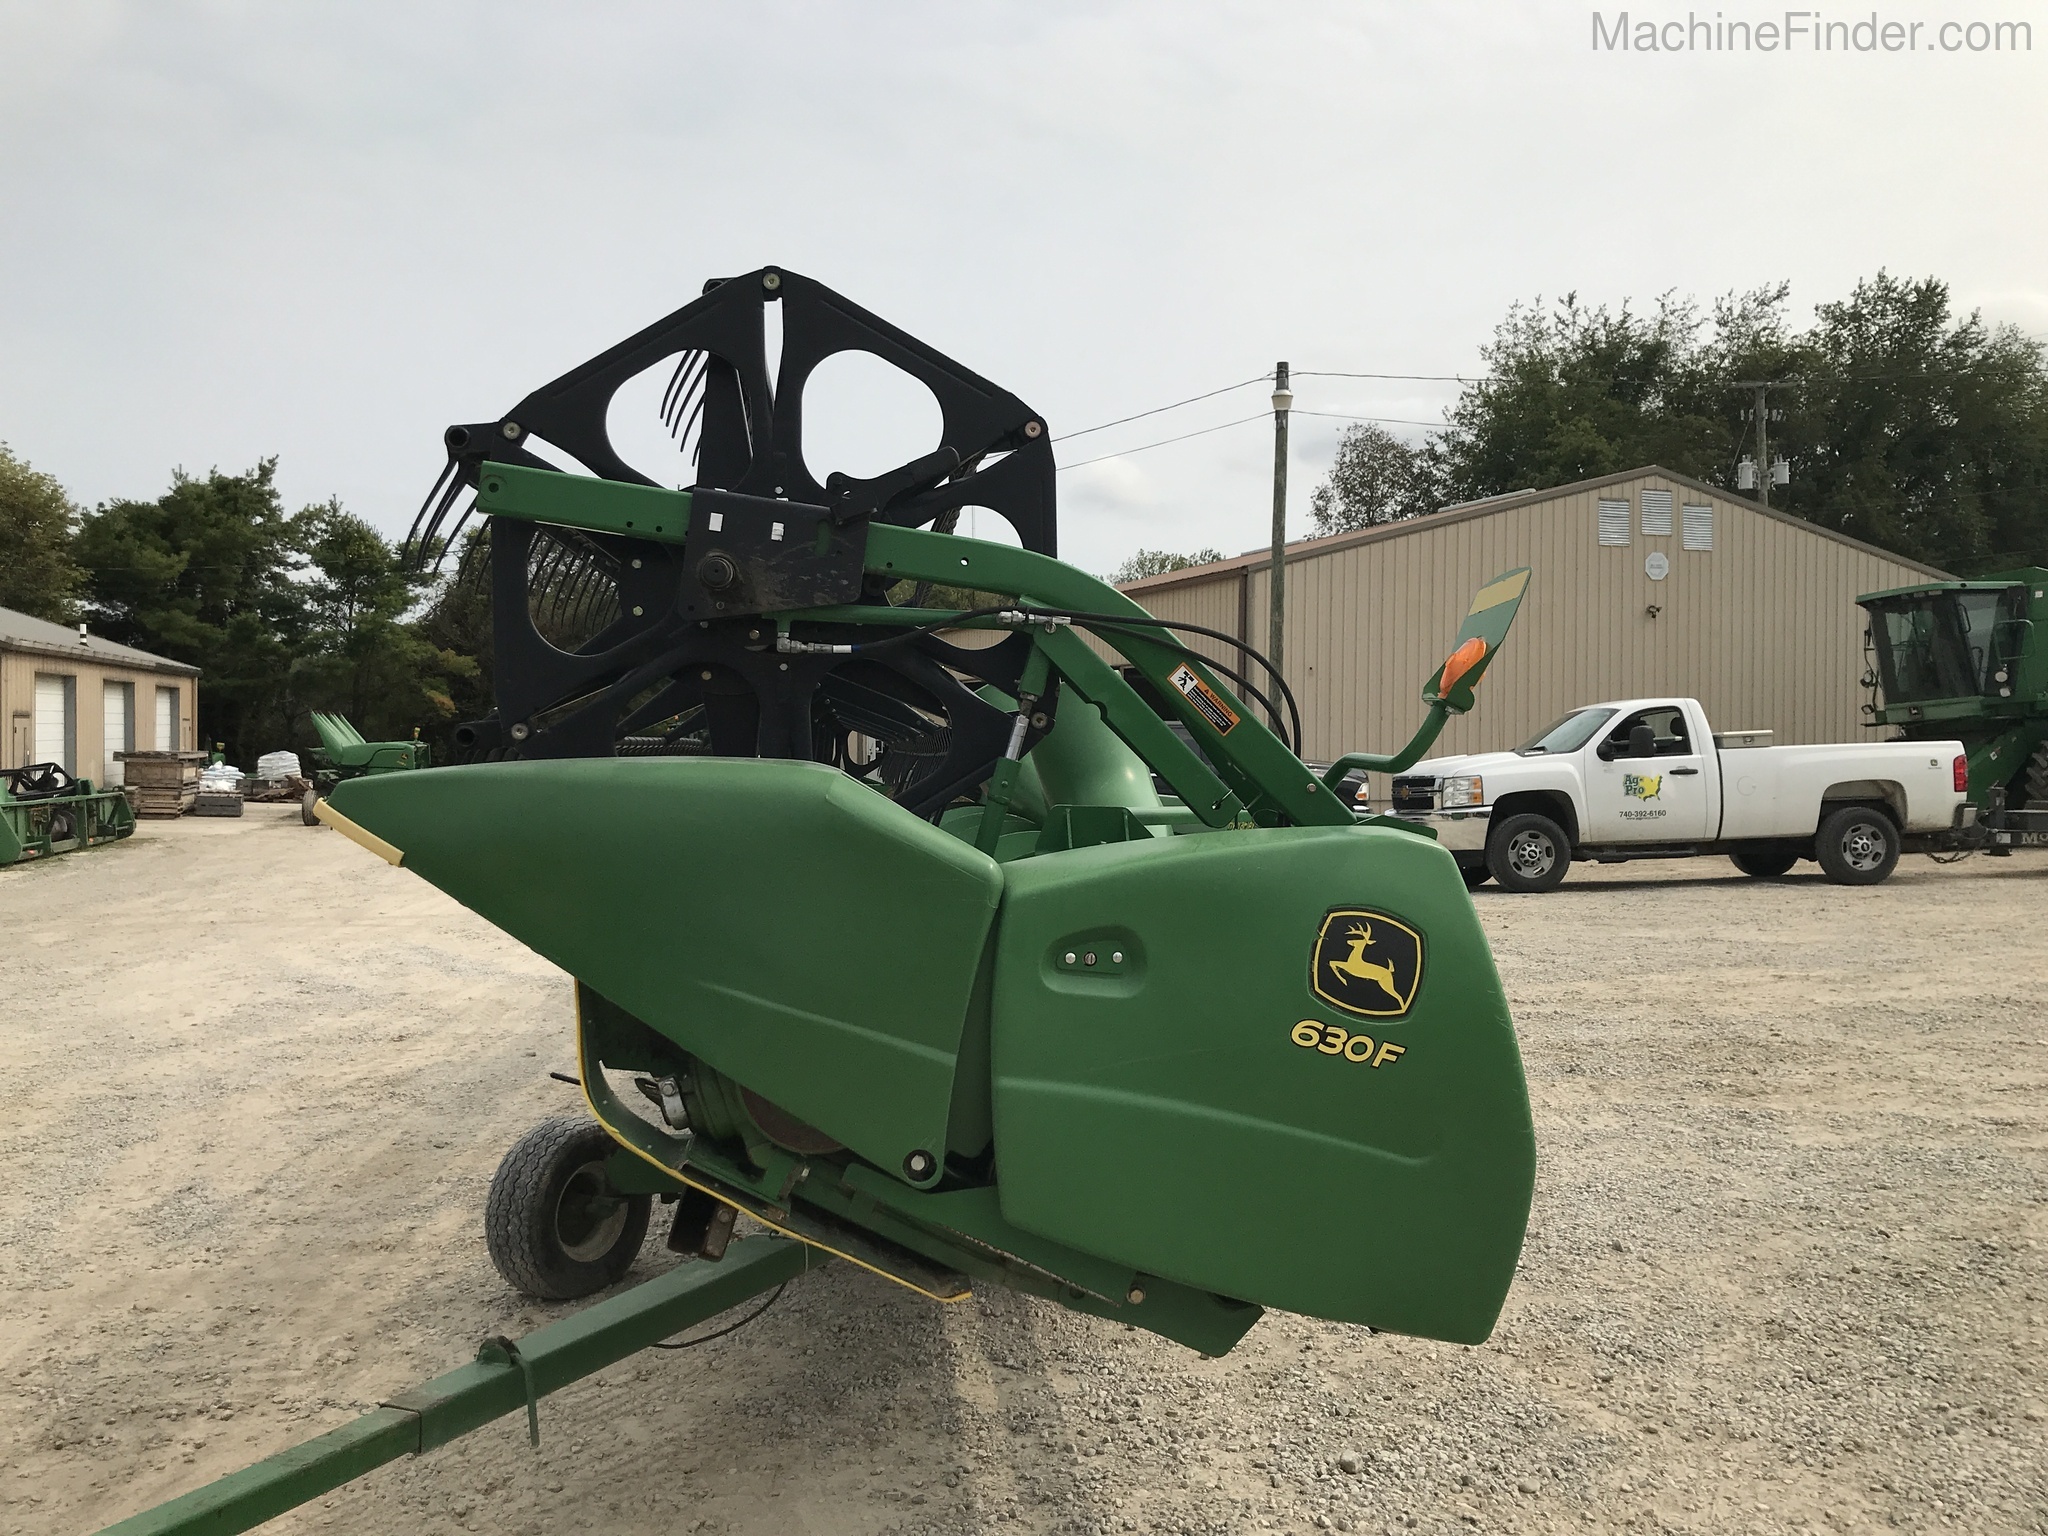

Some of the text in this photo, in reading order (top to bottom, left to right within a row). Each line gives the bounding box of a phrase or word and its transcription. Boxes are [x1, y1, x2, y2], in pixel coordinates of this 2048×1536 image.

[1209, 692, 1233, 718] WARNING
[1624, 774, 1643, 786] Ag-
[1625, 785, 1645, 795] Pro
[1619, 810, 1667, 818] 740-392-6160
[1290, 1018, 1408, 1069] 630F
